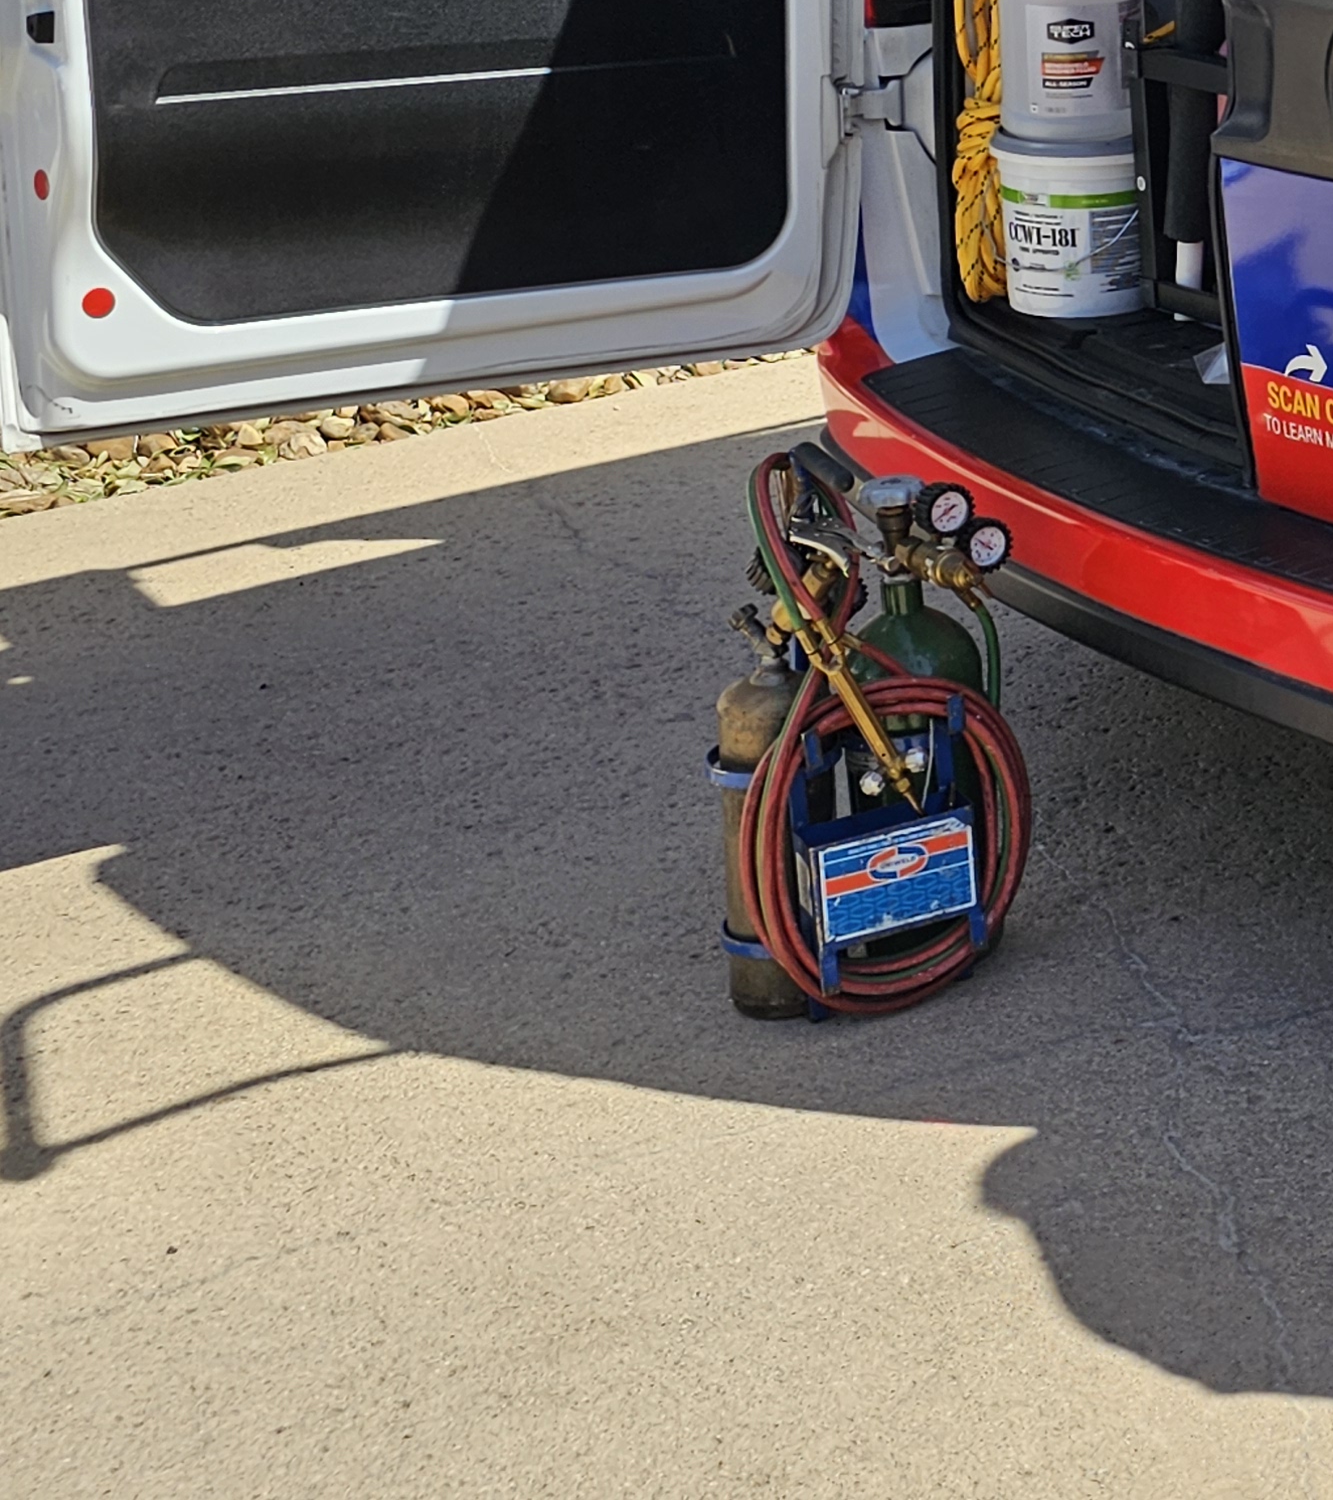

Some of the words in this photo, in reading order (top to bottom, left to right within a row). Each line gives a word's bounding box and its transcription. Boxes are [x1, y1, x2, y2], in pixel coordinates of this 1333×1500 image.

[1052, 28, 1091, 38] TECH
[1267, 381, 1320, 420] SCAN
[1263, 412, 1281, 435] TO
[1282, 420, 1324, 447] LEARN
